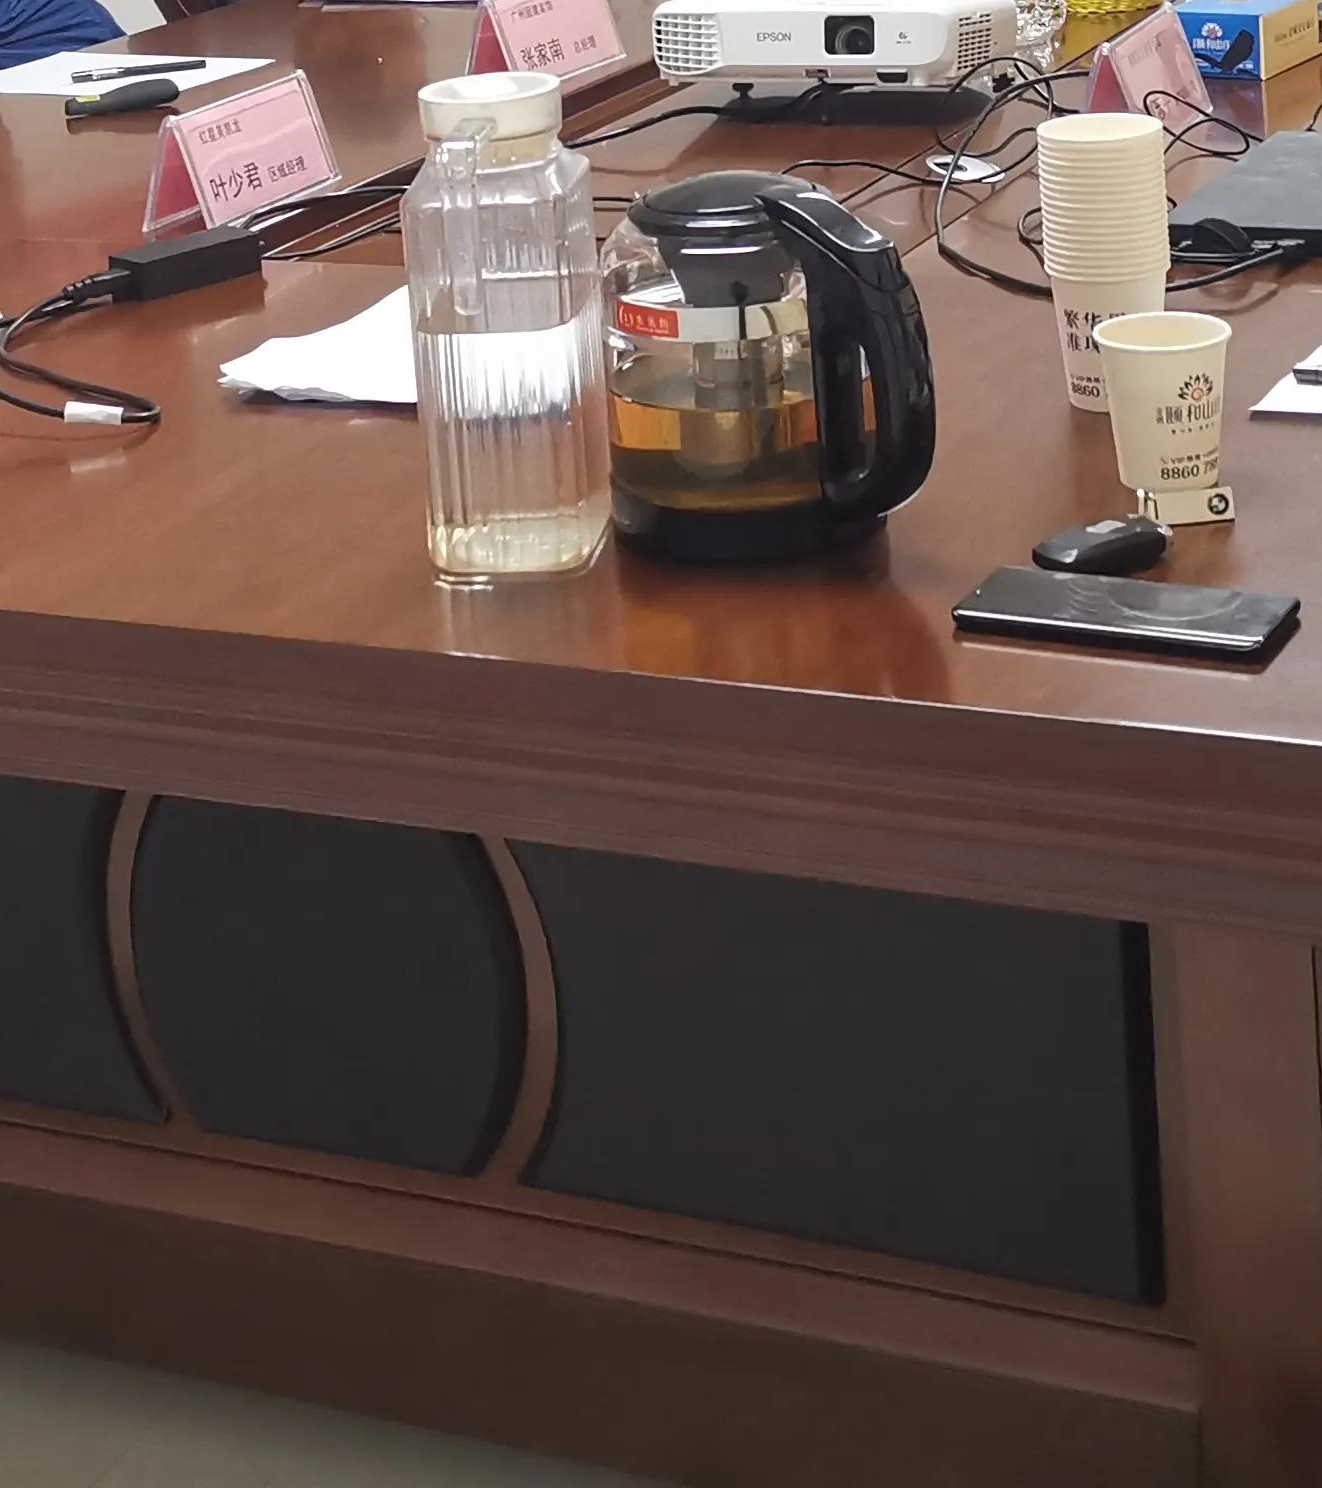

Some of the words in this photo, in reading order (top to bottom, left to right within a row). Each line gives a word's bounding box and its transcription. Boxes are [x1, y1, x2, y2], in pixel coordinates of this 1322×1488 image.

[756, 32, 792, 43] EPSON
[209, 162, 264, 203] 叶少君
[268, 155, 308, 183] 区域经理
[1160, 464, 1200, 481] 8860
